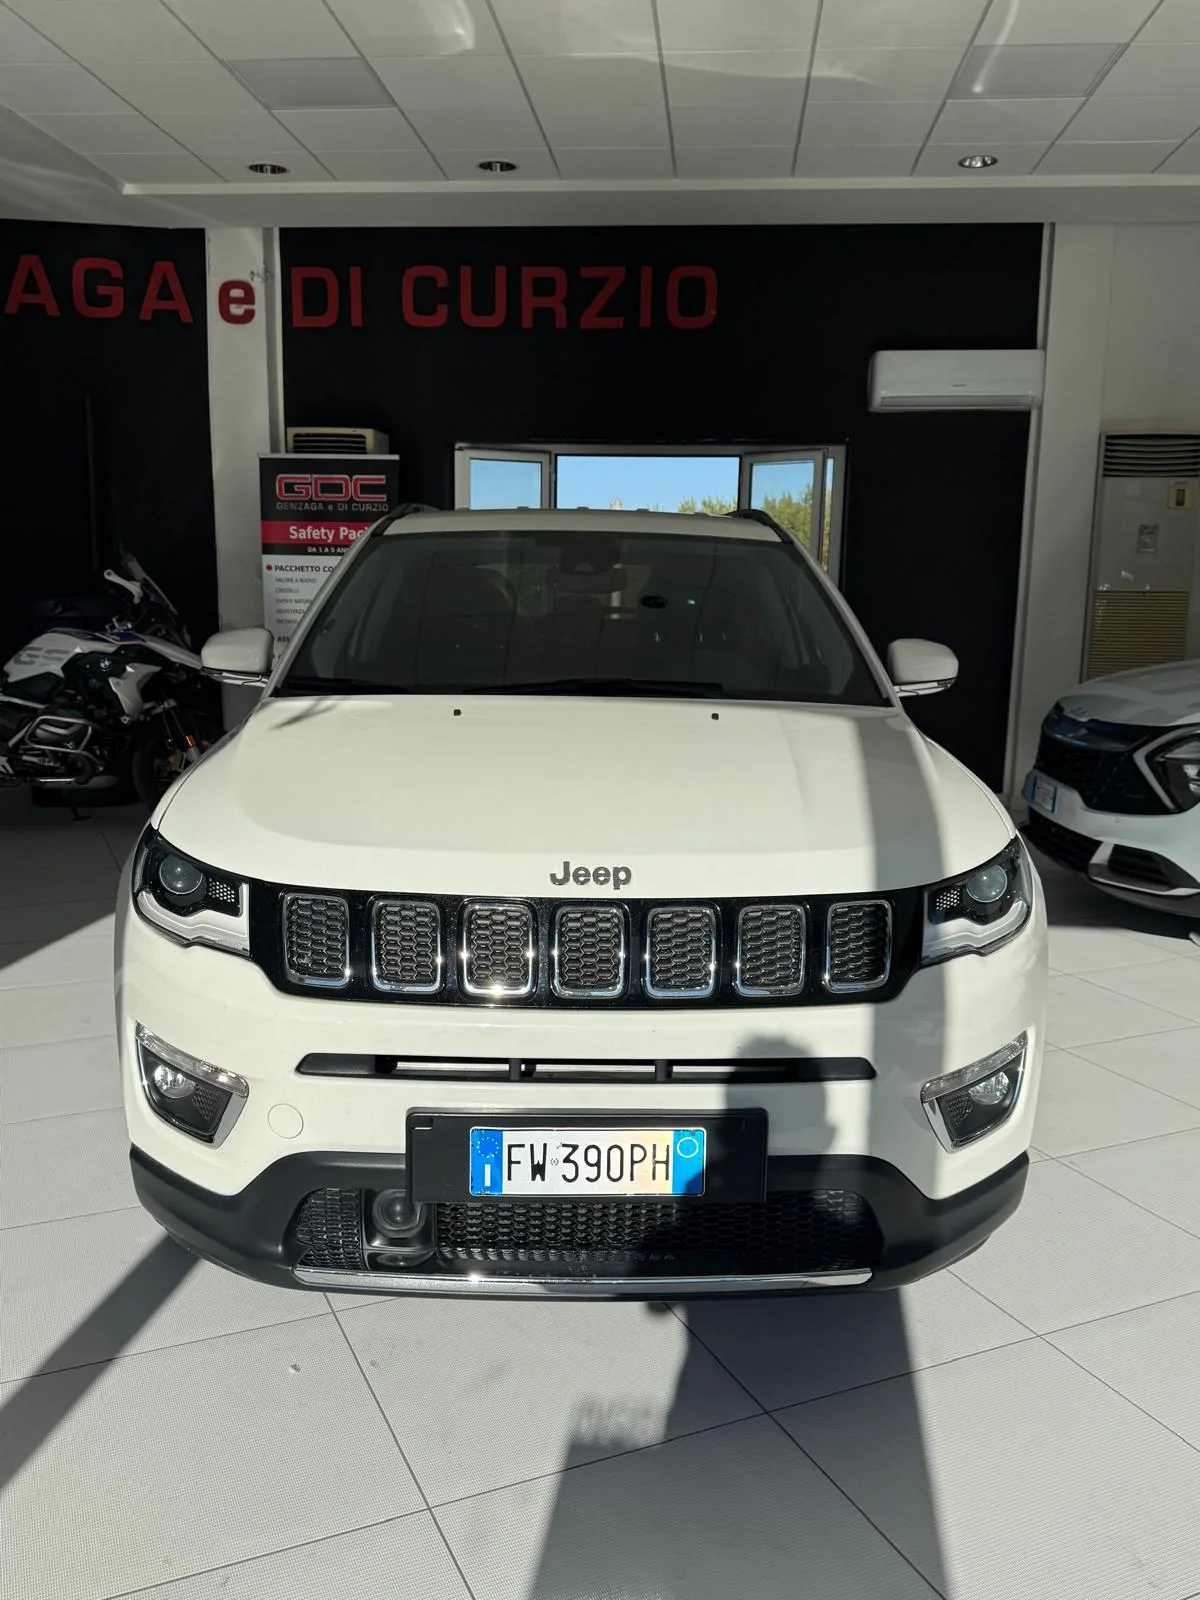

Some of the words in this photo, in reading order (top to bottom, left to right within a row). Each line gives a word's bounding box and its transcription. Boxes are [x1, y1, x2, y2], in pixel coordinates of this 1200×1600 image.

[218, 280, 256, 325] e
[291, 266, 363, 327] DI
[402, 265, 718, 329] CURZIO
[276, 474, 387, 501] GDC
[276, 502, 324, 511] GENZAGA
[328, 503, 334, 511] e
[337, 503, 348, 511] DI
[352, 503, 389, 512] CURZIO
[289, 526, 335, 543] Safety
[339, 526, 372, 540] Pac
[274, 565, 320, 573] PACCHETTO
[549, 861, 632, 890] Jeep
